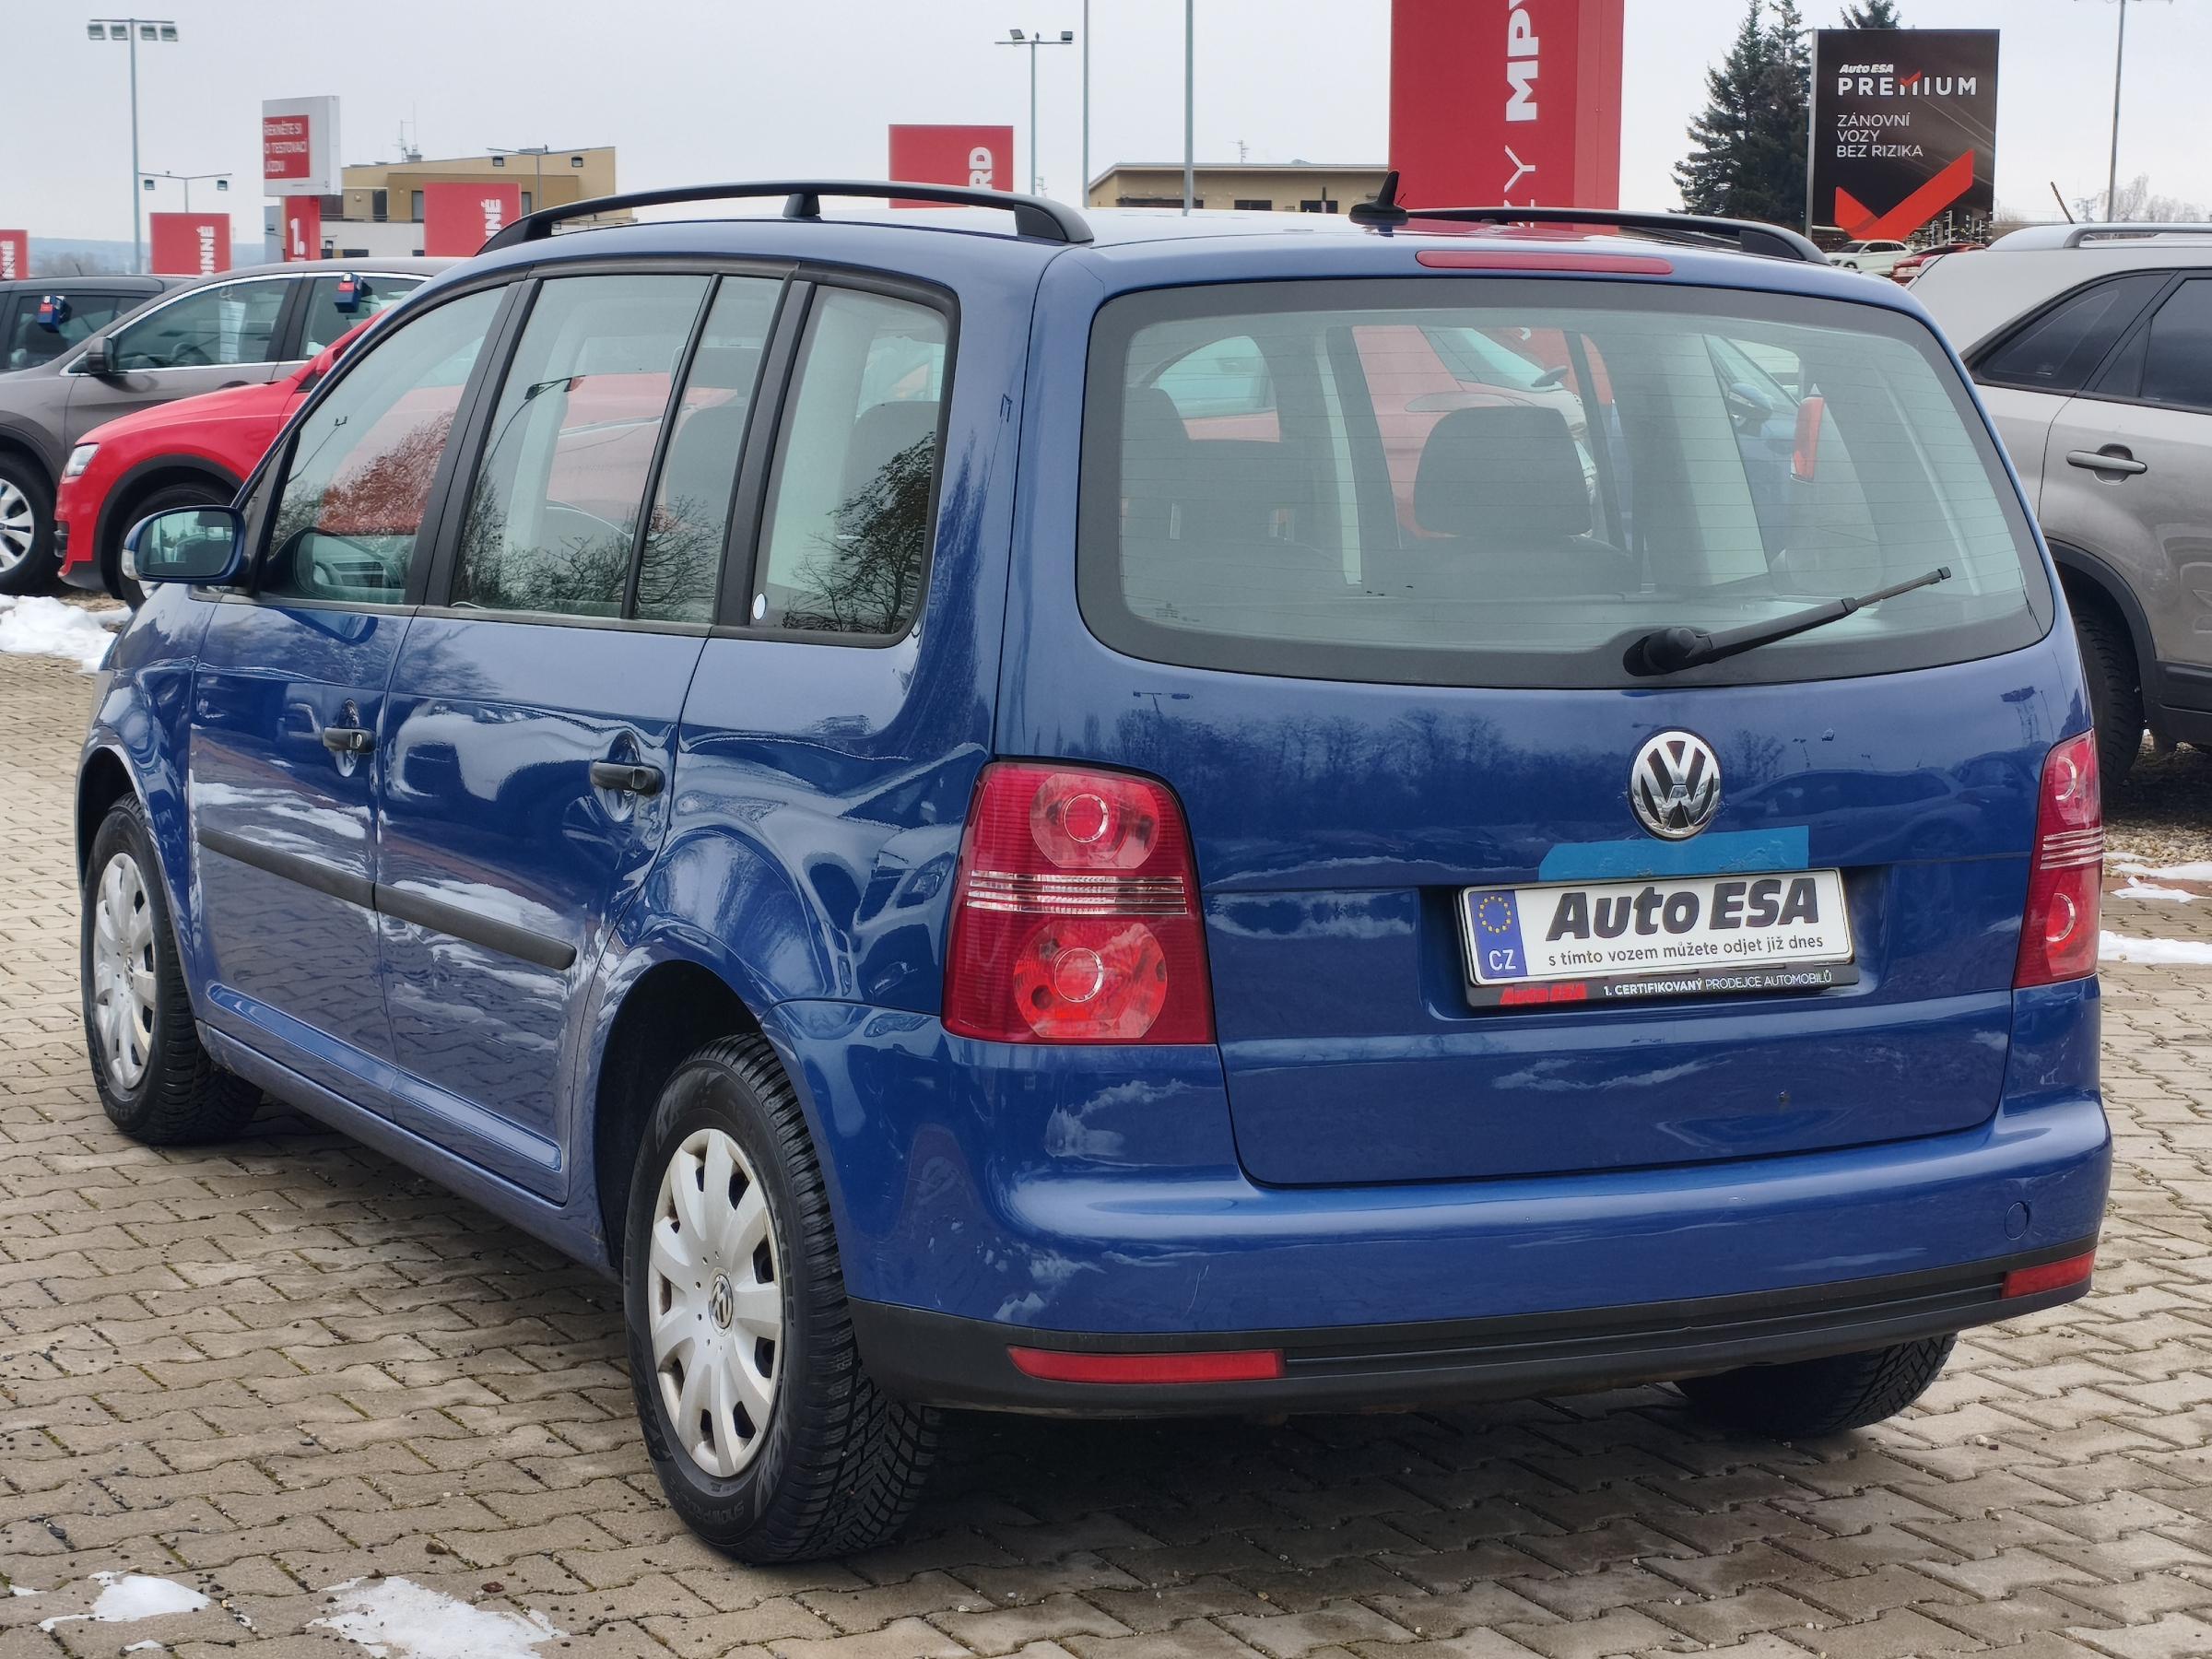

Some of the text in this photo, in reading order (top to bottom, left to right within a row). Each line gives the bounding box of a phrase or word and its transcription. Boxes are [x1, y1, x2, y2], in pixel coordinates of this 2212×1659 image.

[1839, 64, 1894, 74] Auto ESA
[1837, 76, 1977, 96] PREMIUM
[1837, 112, 1911, 127] ZÁNOVNÍ
[1837, 129, 1880, 143] VOZY
[1836, 145, 1924, 158] BEZ RIZIKA
[1545, 877, 1819, 941] Auto ESA
[1488, 948, 1516, 971] CZ
[1547, 934, 1823, 966] s tímto vozem můžete odjet již dnes
[1604, 969, 1832, 996] 1. CERTIFIKOVANÝ PRODEJCE AUTOMOBILŮ
